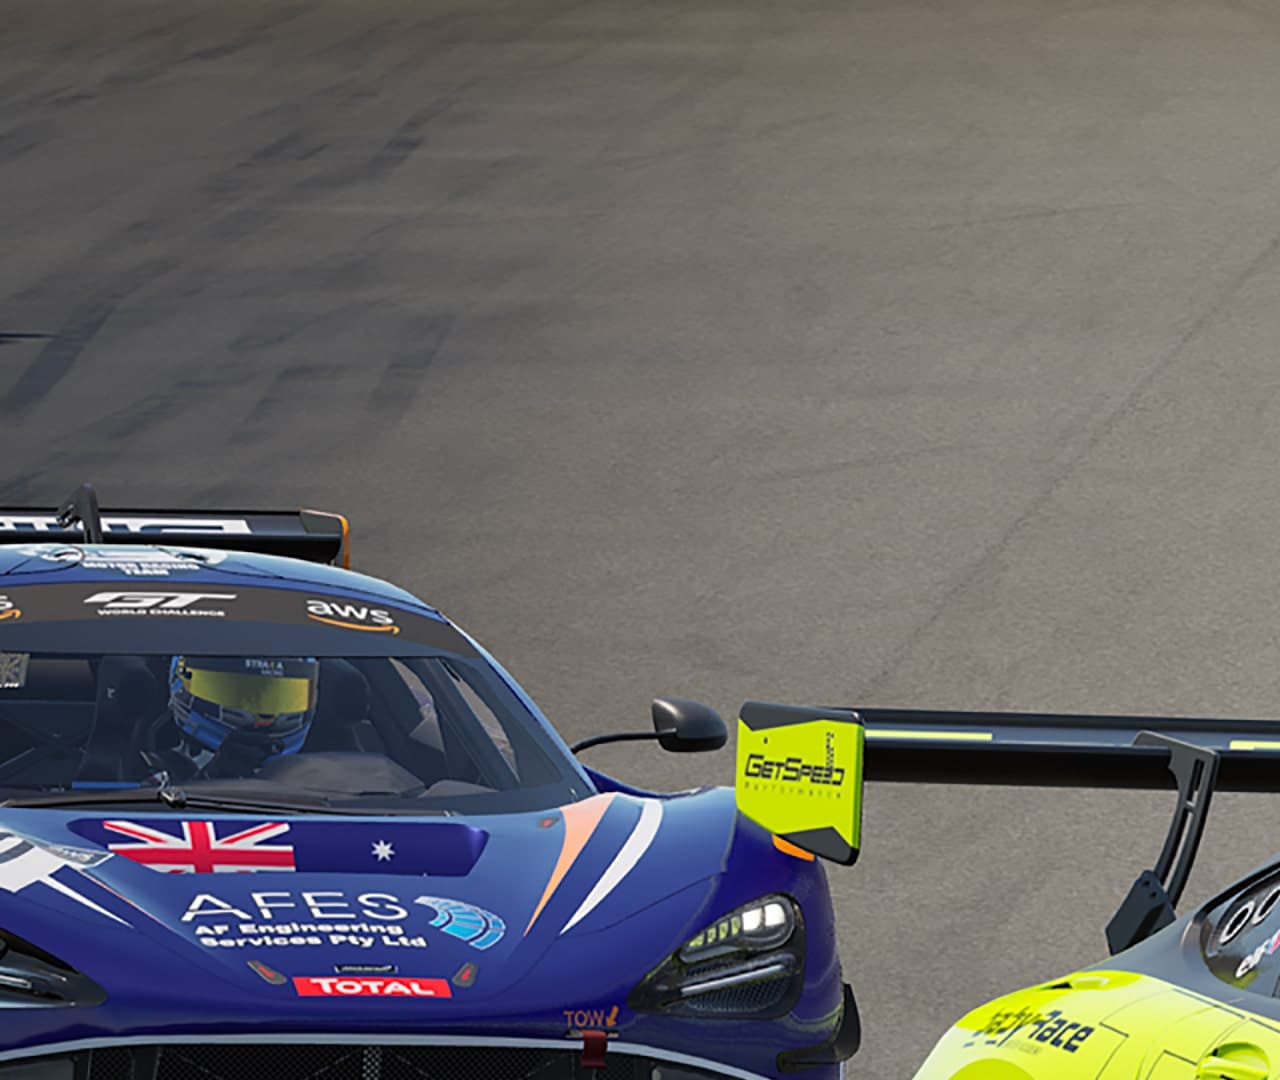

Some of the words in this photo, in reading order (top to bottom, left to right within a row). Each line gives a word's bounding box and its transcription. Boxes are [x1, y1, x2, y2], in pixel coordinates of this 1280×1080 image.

[84, 592, 237, 608] GT
[150, 609, 226, 617] CHALLENGE
[306, 601, 395, 625] aws
[180, 892, 409, 921] AFES
[195, 924, 230, 936] AF
[238, 923, 405, 936] Engineering
[199, 936, 323, 948] Services
[329, 936, 375, 948] Pty
[381, 936, 428, 948] Ltd
[309, 978, 435, 995] TOTAL
[563, 1010, 605, 1028] TOW
